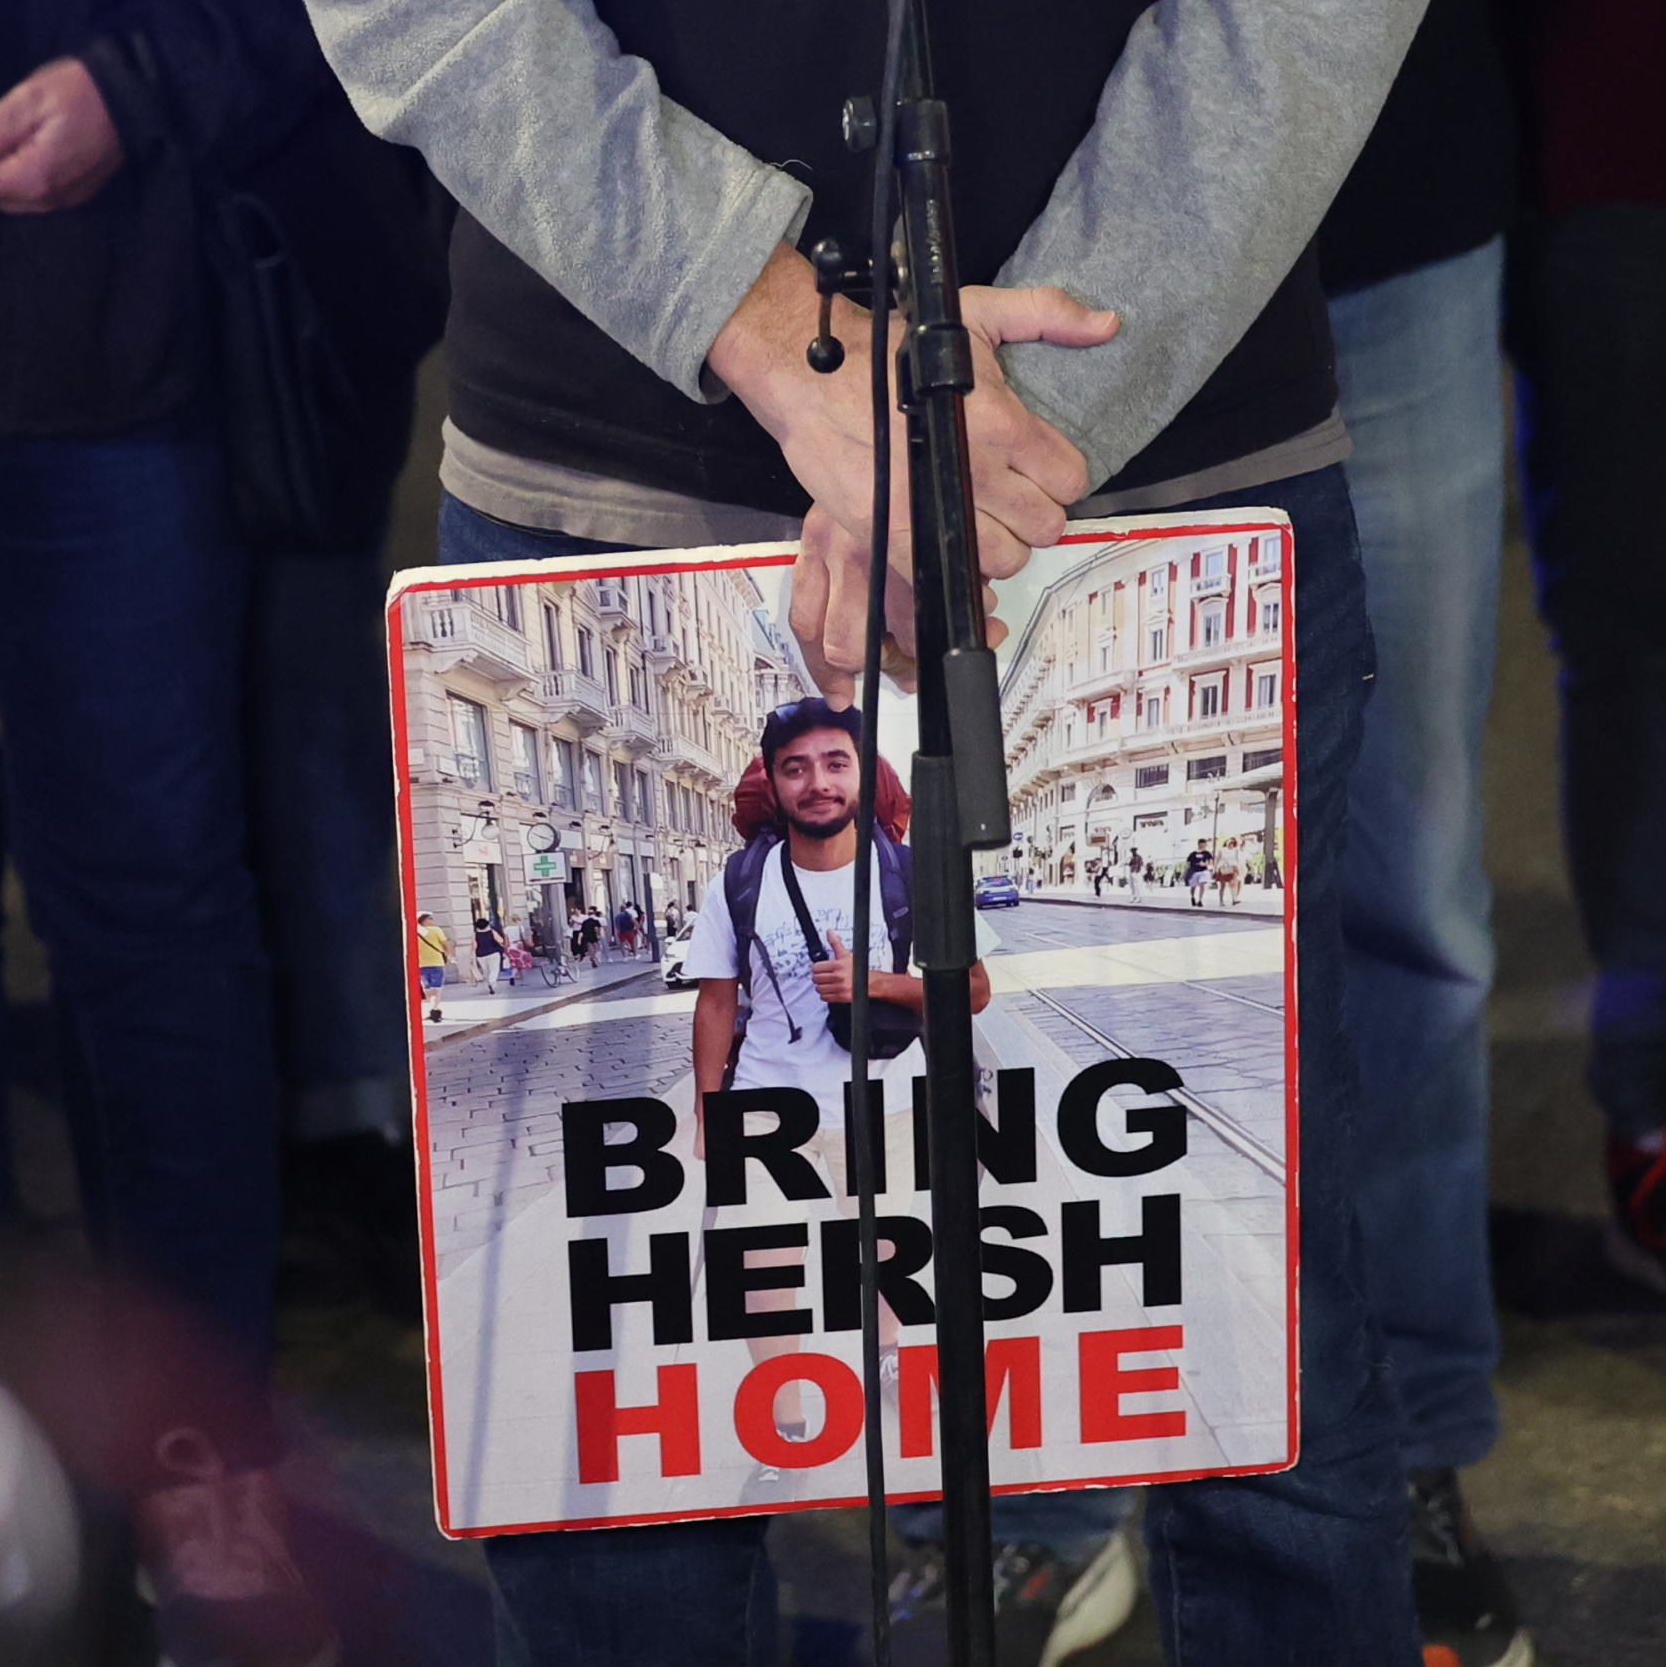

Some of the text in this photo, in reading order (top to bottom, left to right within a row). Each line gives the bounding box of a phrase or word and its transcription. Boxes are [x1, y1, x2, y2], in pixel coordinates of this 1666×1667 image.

[561, 1057, 1188, 1218] BRING
[568, 1193, 1182, 1352] HERSH
[574, 1324, 1187, 1485] HOME
